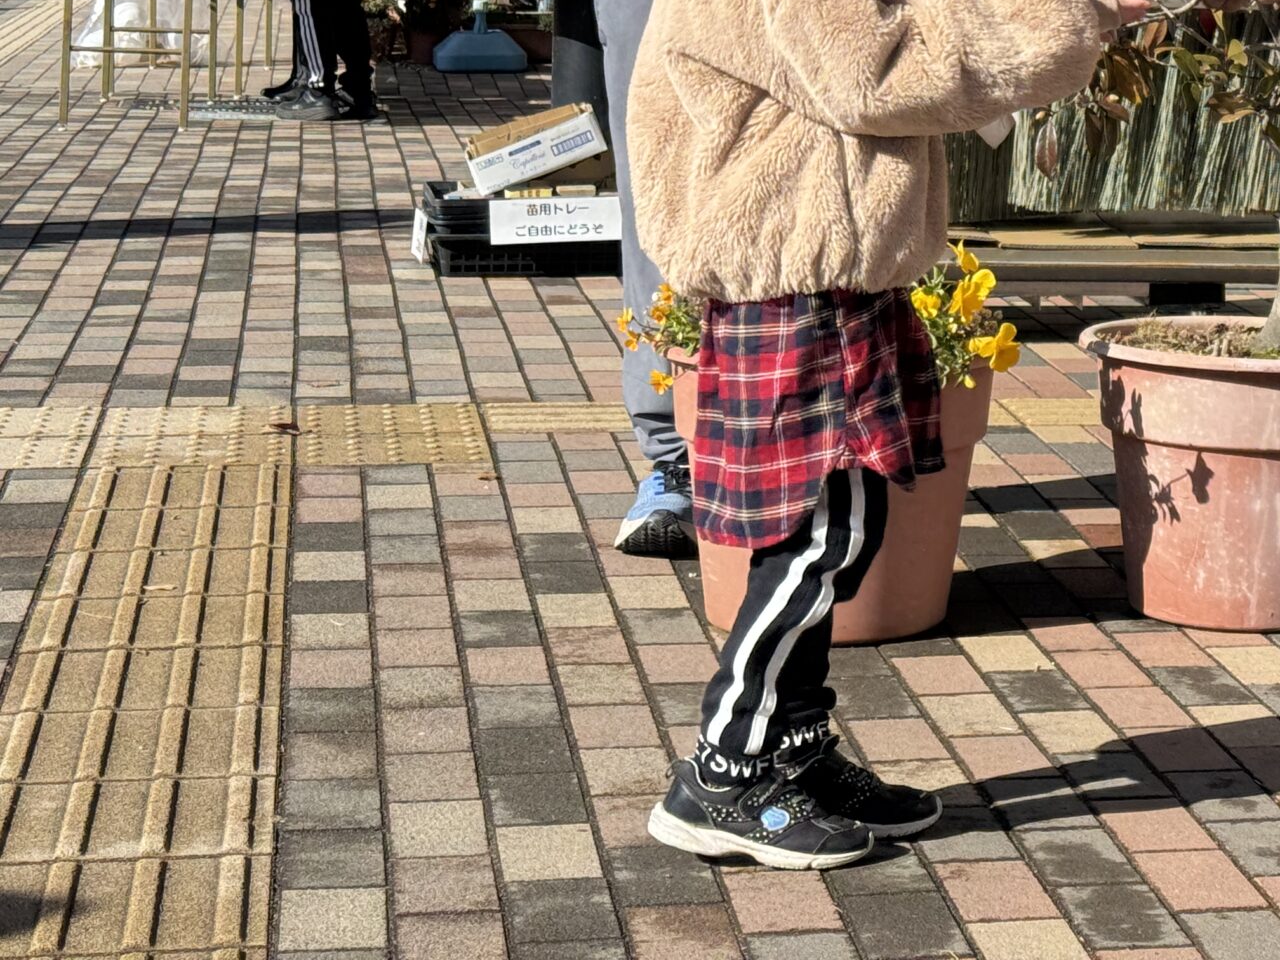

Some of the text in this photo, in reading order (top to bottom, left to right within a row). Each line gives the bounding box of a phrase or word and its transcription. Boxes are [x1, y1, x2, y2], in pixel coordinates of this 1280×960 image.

[526, 203, 590, 216] 苗用トレー
[515, 223, 604, 237] ご自由にどうぞ
